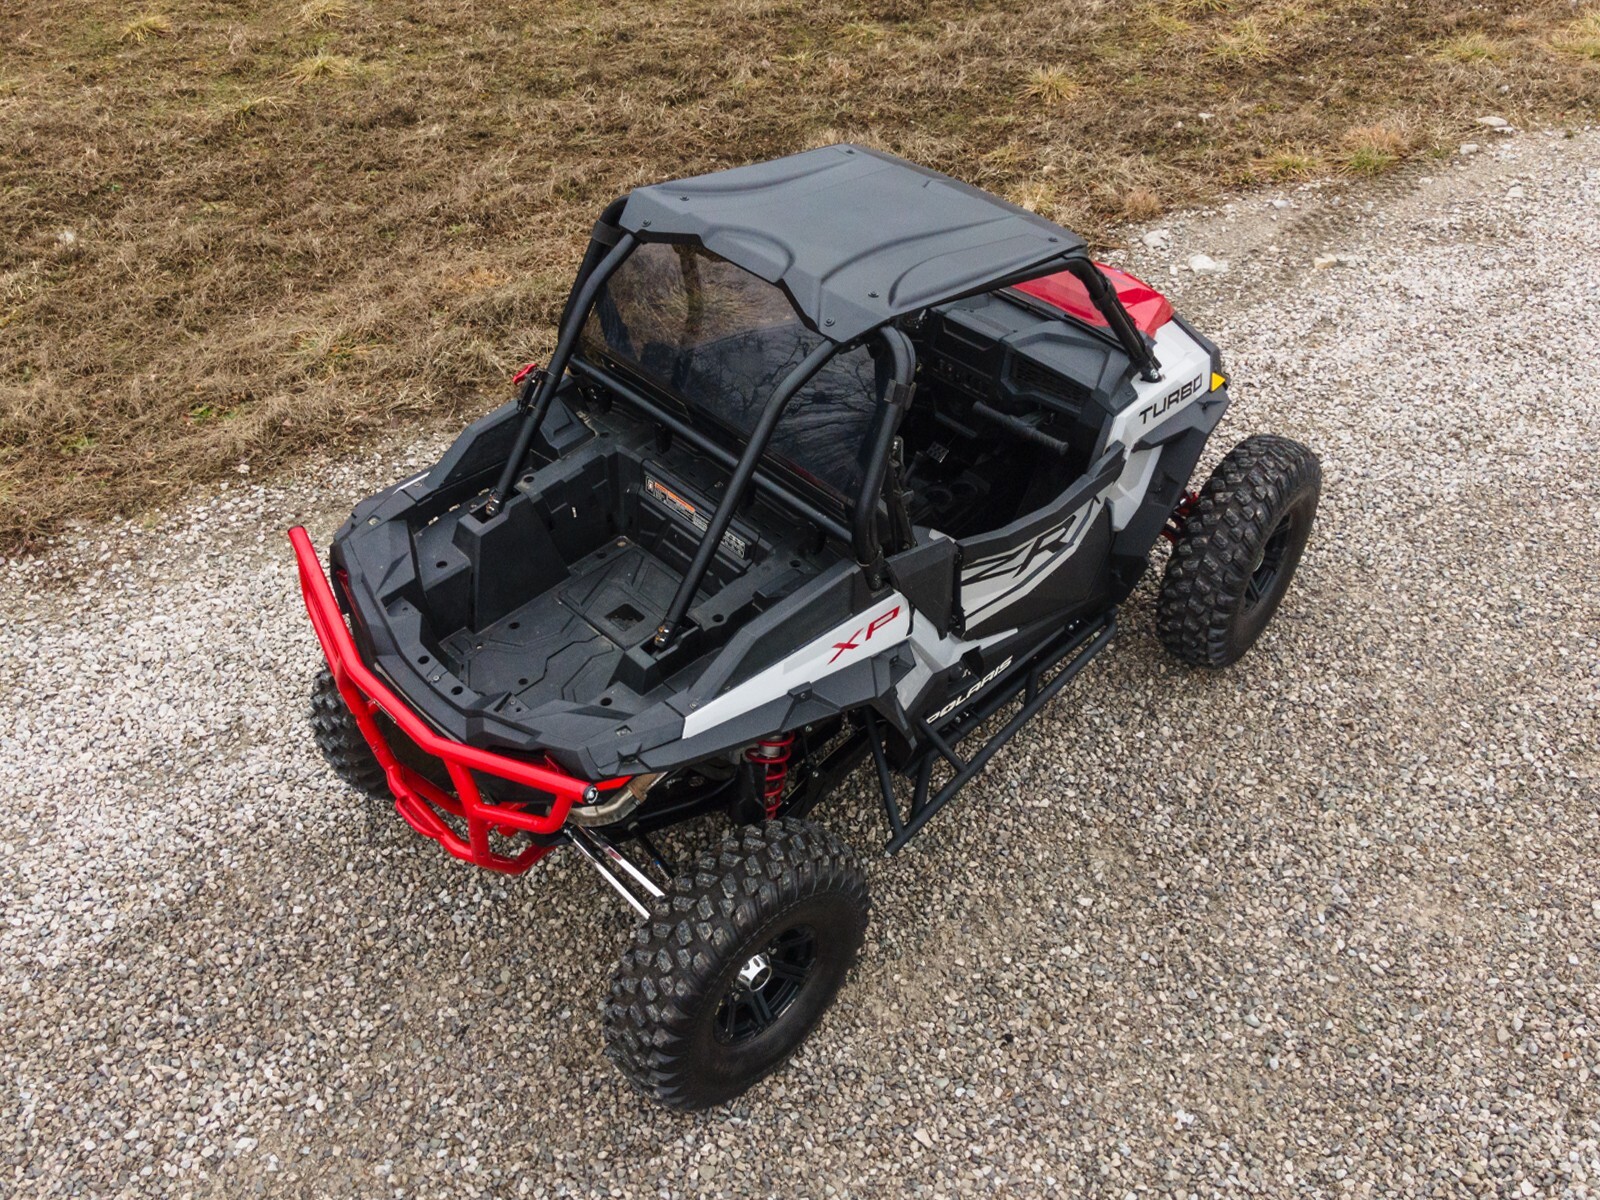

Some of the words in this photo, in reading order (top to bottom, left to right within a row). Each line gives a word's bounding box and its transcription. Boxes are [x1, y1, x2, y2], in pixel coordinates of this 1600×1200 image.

[1139, 373, 1203, 425] TURBO
[827, 606, 901, 666] XP
[926, 655, 1014, 725] POLARIS
